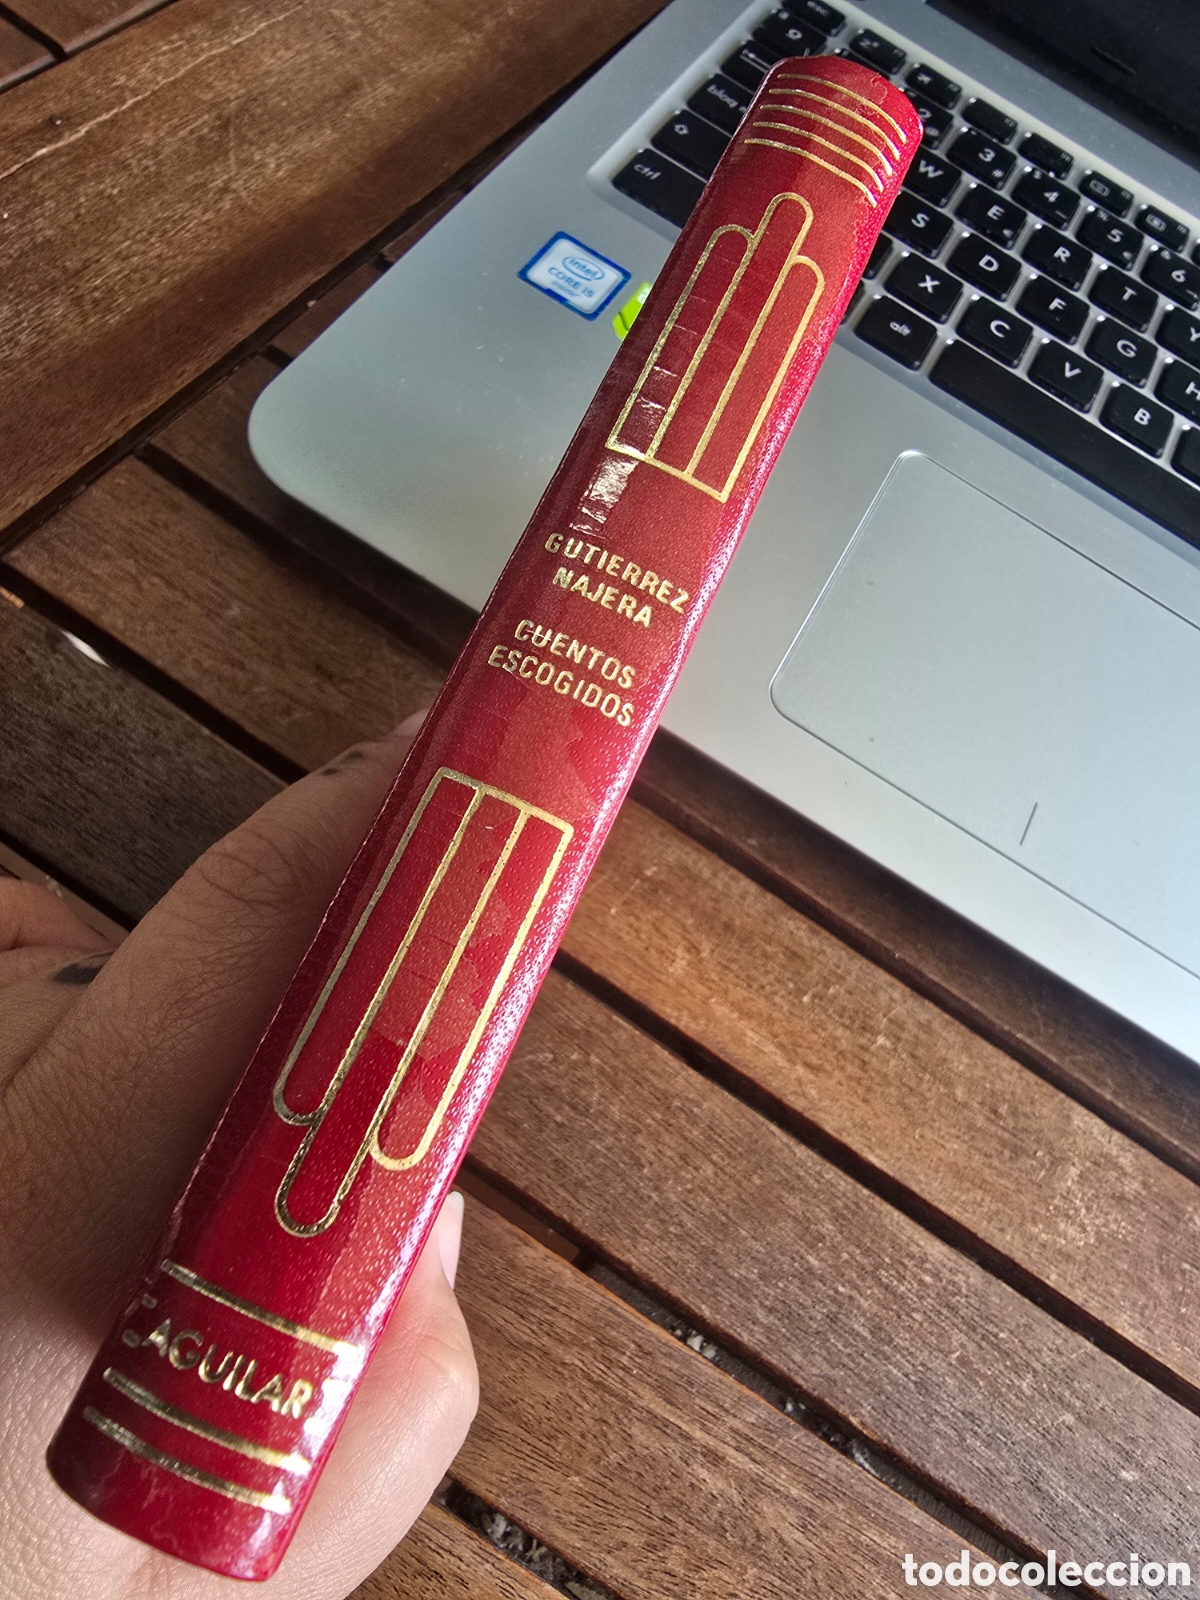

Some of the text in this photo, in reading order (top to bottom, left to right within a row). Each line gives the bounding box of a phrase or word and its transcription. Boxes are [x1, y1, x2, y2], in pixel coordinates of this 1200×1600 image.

[978, 147, 996, 162] 3
[634, 164, 661, 180] ctrl
[918, 159, 945, 179] W
[1043, 191, 1060, 203] 4
[911, 212, 930, 229] S
[986, 204, 1005, 221] E
[1106, 228, 1125, 243] 5
[978, 254, 1000, 272] D
[1053, 246, 1072, 263] R
[547, 266, 581, 290] CORE
[917, 274, 941, 294] X
[1171, 269, 1187, 283] 6
[1122, 286, 1138, 301] T
[1048, 297, 1068, 312] F
[989, 319, 1011, 338] C
[1116, 339, 1138, 358] G
[1064, 361, 1082, 378] V
[1133, 407, 1152, 425] B
[544, 532, 690, 614] GUTIERREZ
[552, 566, 653, 628] NAJERA
[514, 619, 637, 689] CUENTOS
[487, 644, 635, 727] ESCOGIDOS
[141, 1317, 314, 1420] AGUILAR
